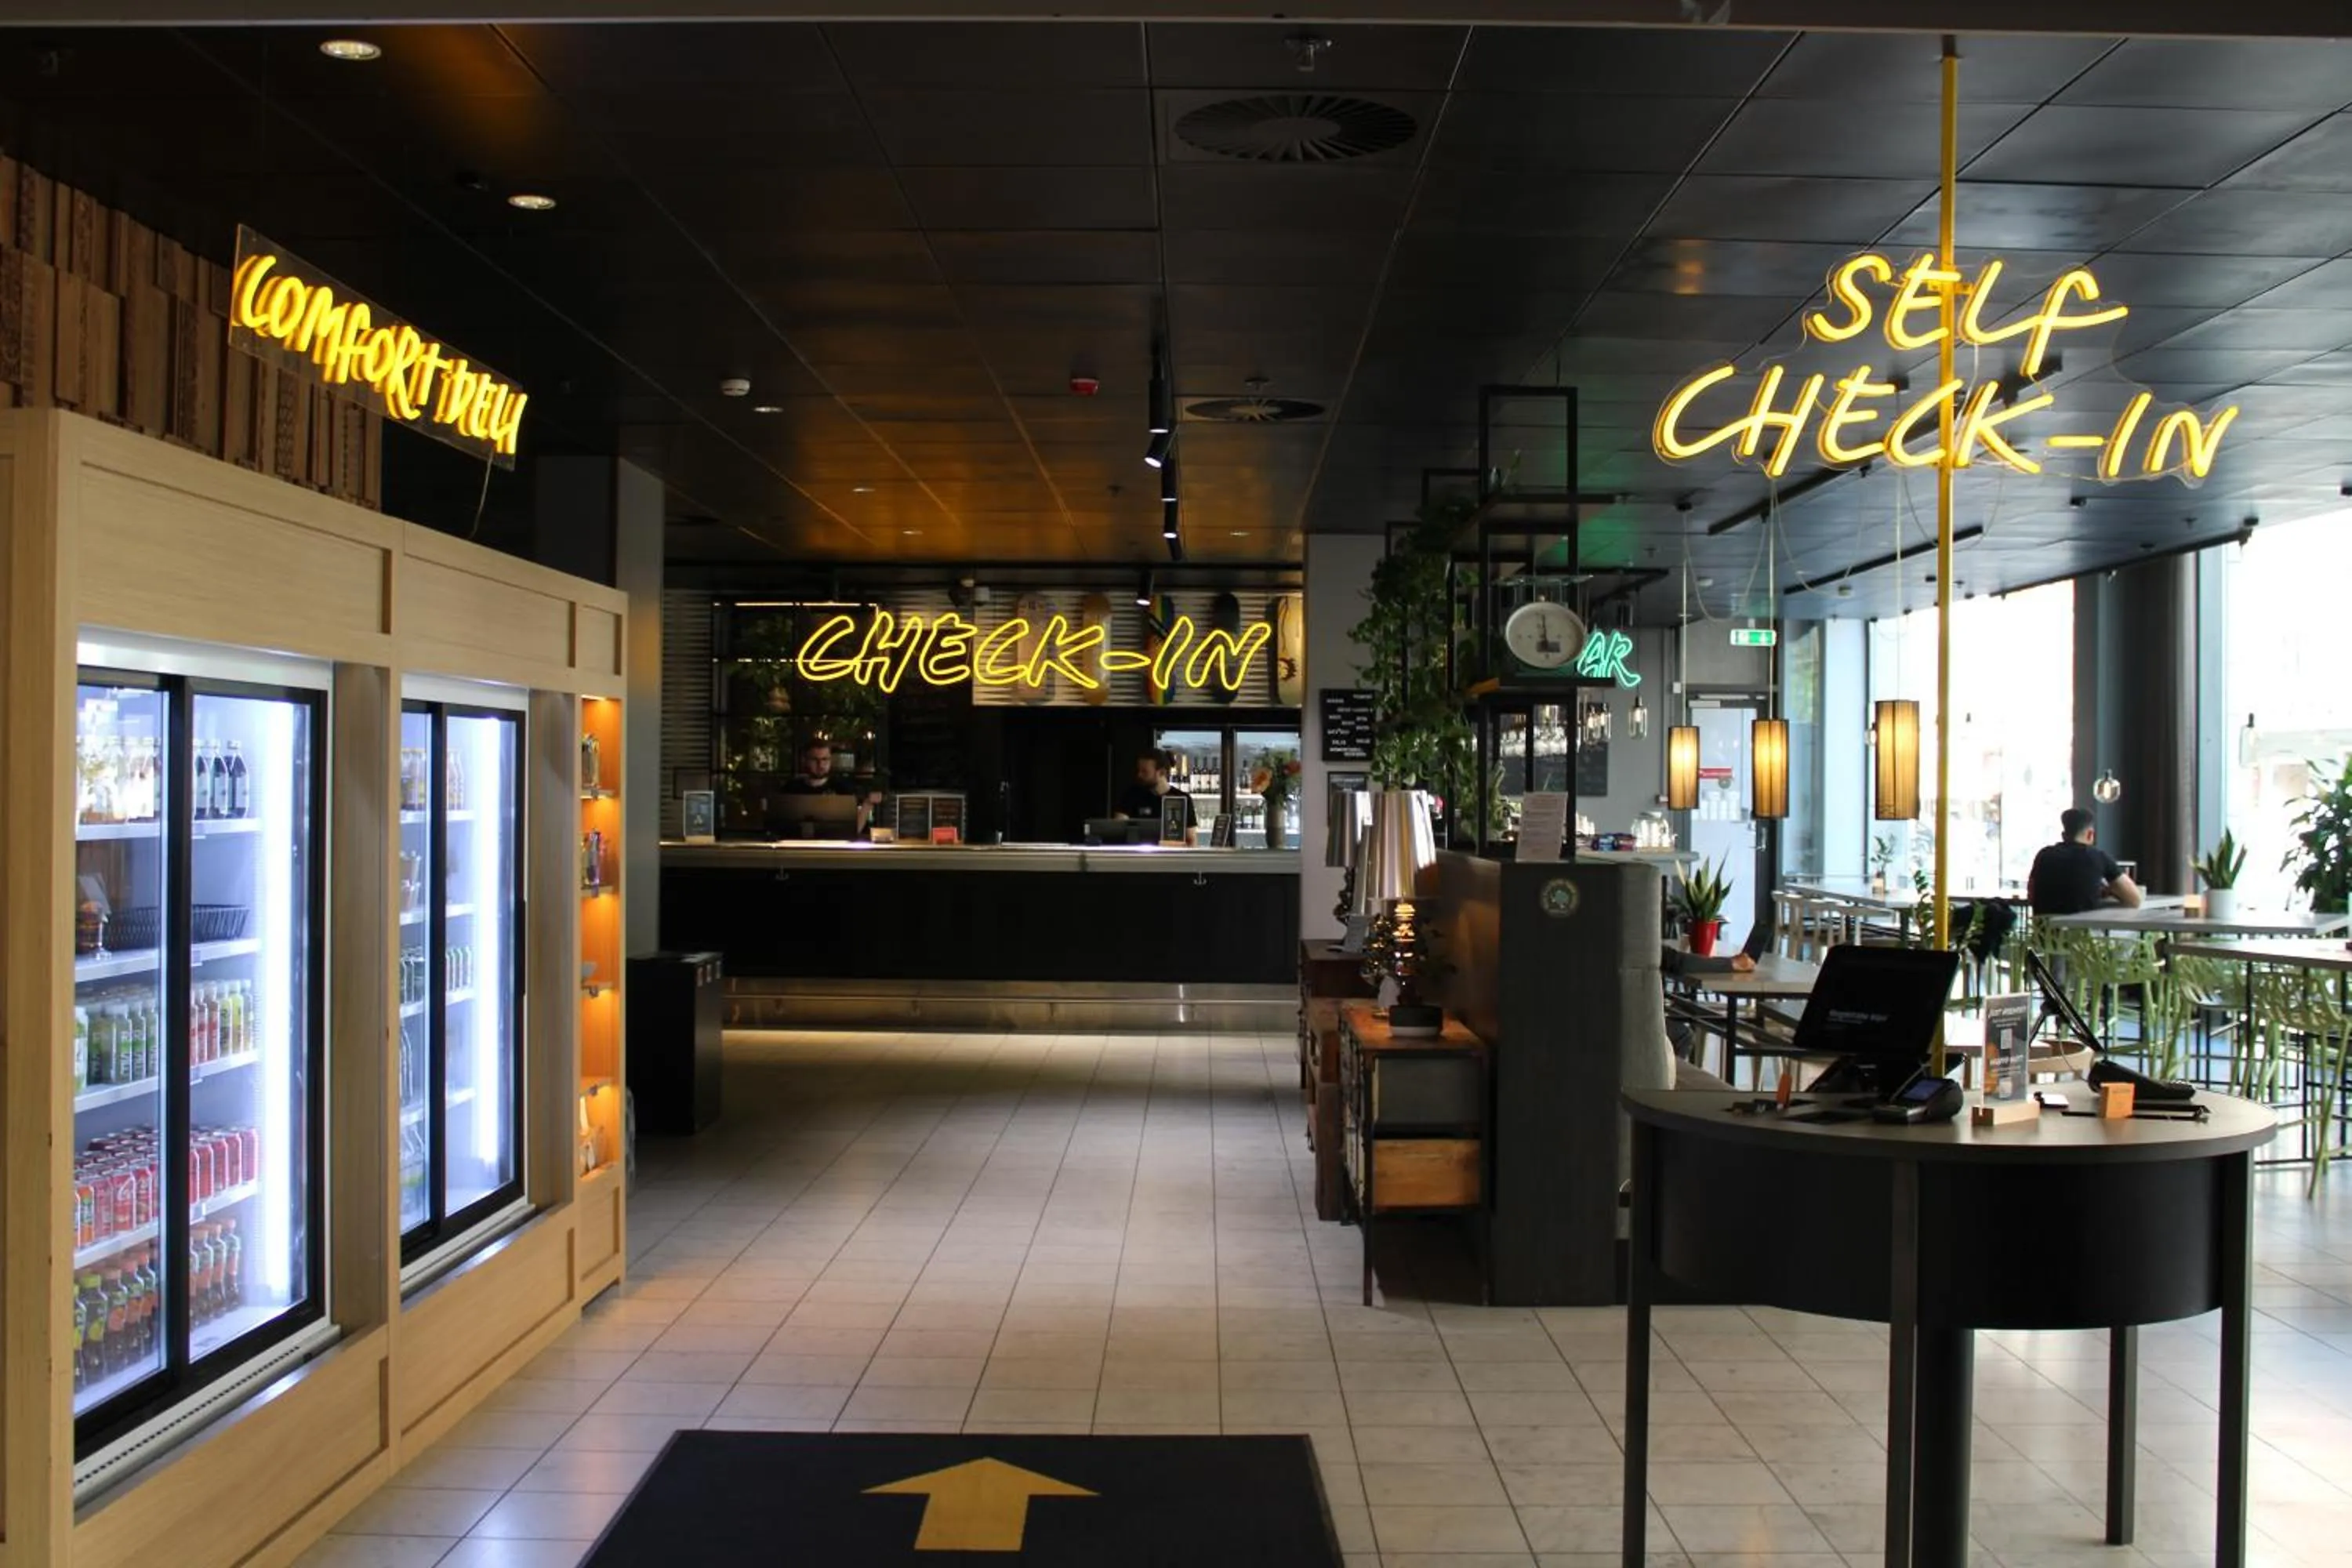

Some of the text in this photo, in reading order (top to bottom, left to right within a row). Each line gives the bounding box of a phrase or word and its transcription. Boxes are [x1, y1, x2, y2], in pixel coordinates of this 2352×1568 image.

[232, 253, 528, 455] COMFORT DELI
[1653, 365, 2241, 478] CHECK-IN
[796, 612, 1272, 693] CHECK-IN
[1576, 630, 1642, 688] AR
